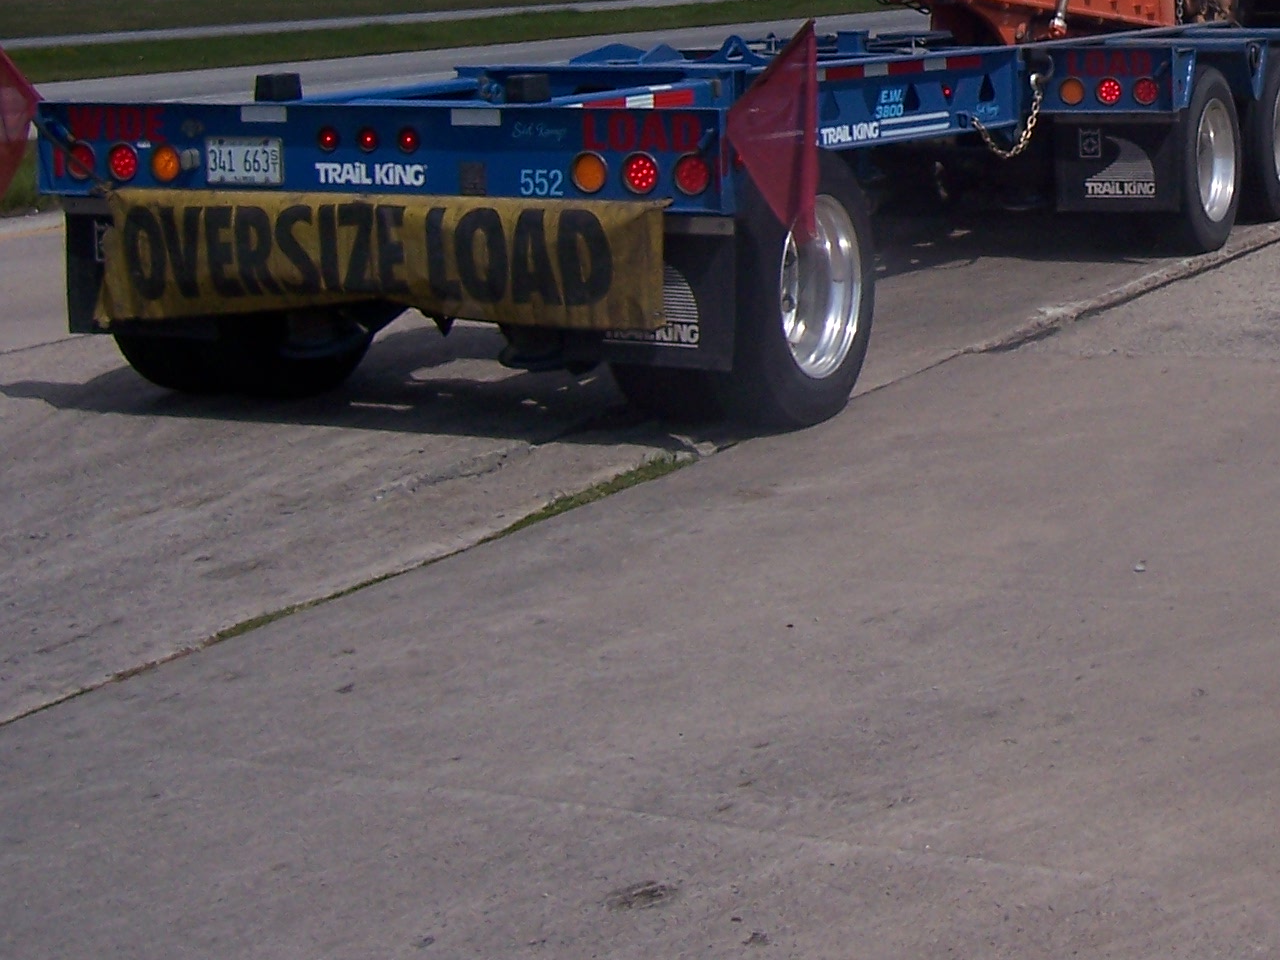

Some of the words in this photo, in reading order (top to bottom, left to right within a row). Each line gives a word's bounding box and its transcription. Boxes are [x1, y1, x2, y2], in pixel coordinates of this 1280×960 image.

[1066, 50, 1153, 77] LOAD
[67, 106, 168, 143] WIDE
[582, 113, 703, 152] LOAD
[208, 149, 235, 172] 341
[243, 149, 270, 173] 663
[520, 169, 564, 196] 552
[123, 203, 408, 300] OVERSIZE
[425, 207, 614, 306] LOAD
